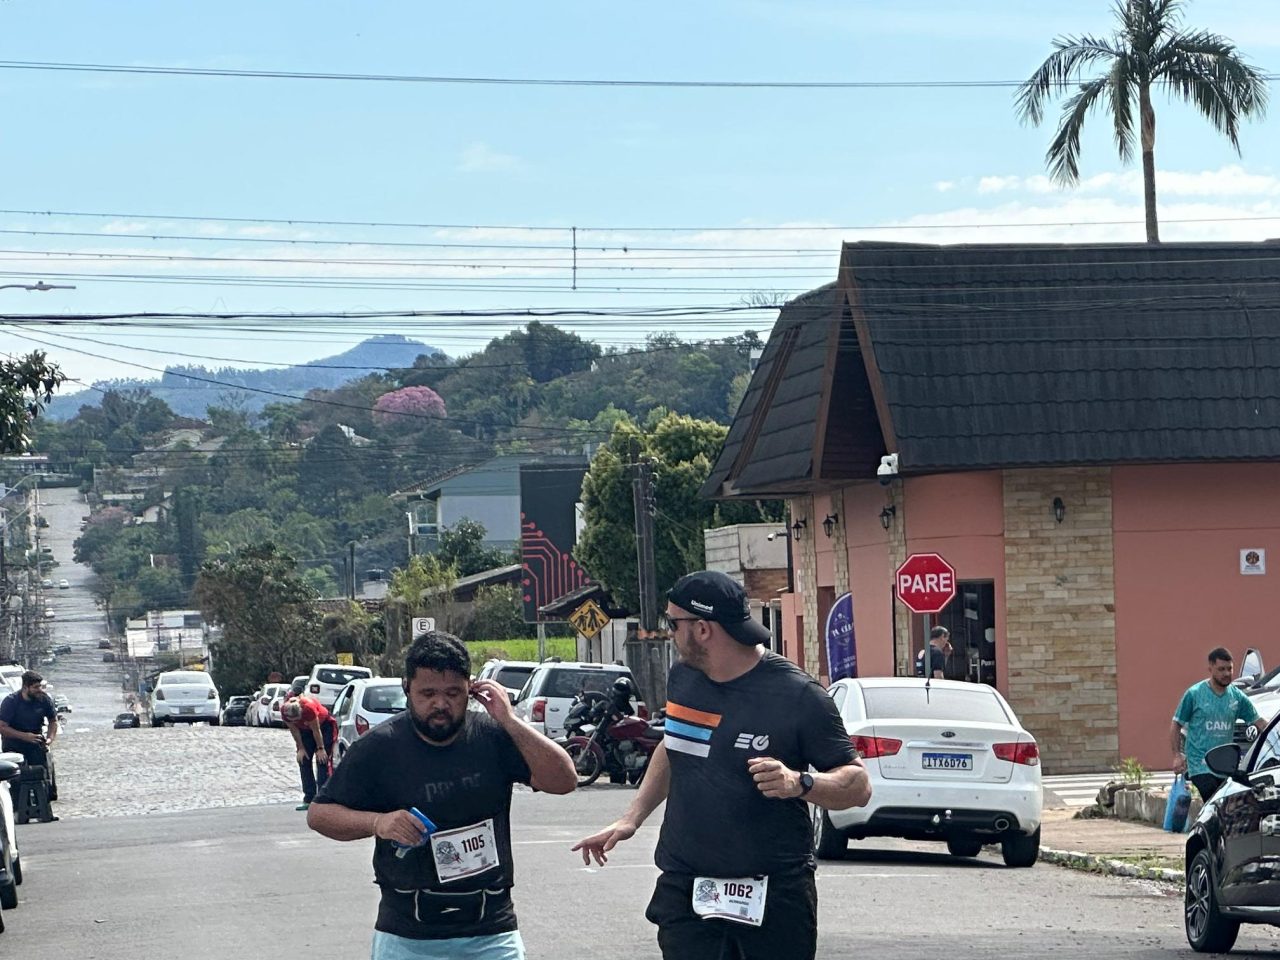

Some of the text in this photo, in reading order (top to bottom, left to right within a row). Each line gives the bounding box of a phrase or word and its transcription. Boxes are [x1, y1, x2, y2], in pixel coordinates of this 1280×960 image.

[900, 573, 952, 594] PARE
[690, 599, 714, 612] Unimed
[419, 621, 427, 631] E
[926, 757, 967, 768] ITX6D76
[461, 835, 485, 853] 1105
[724, 883, 753, 899] 1062
